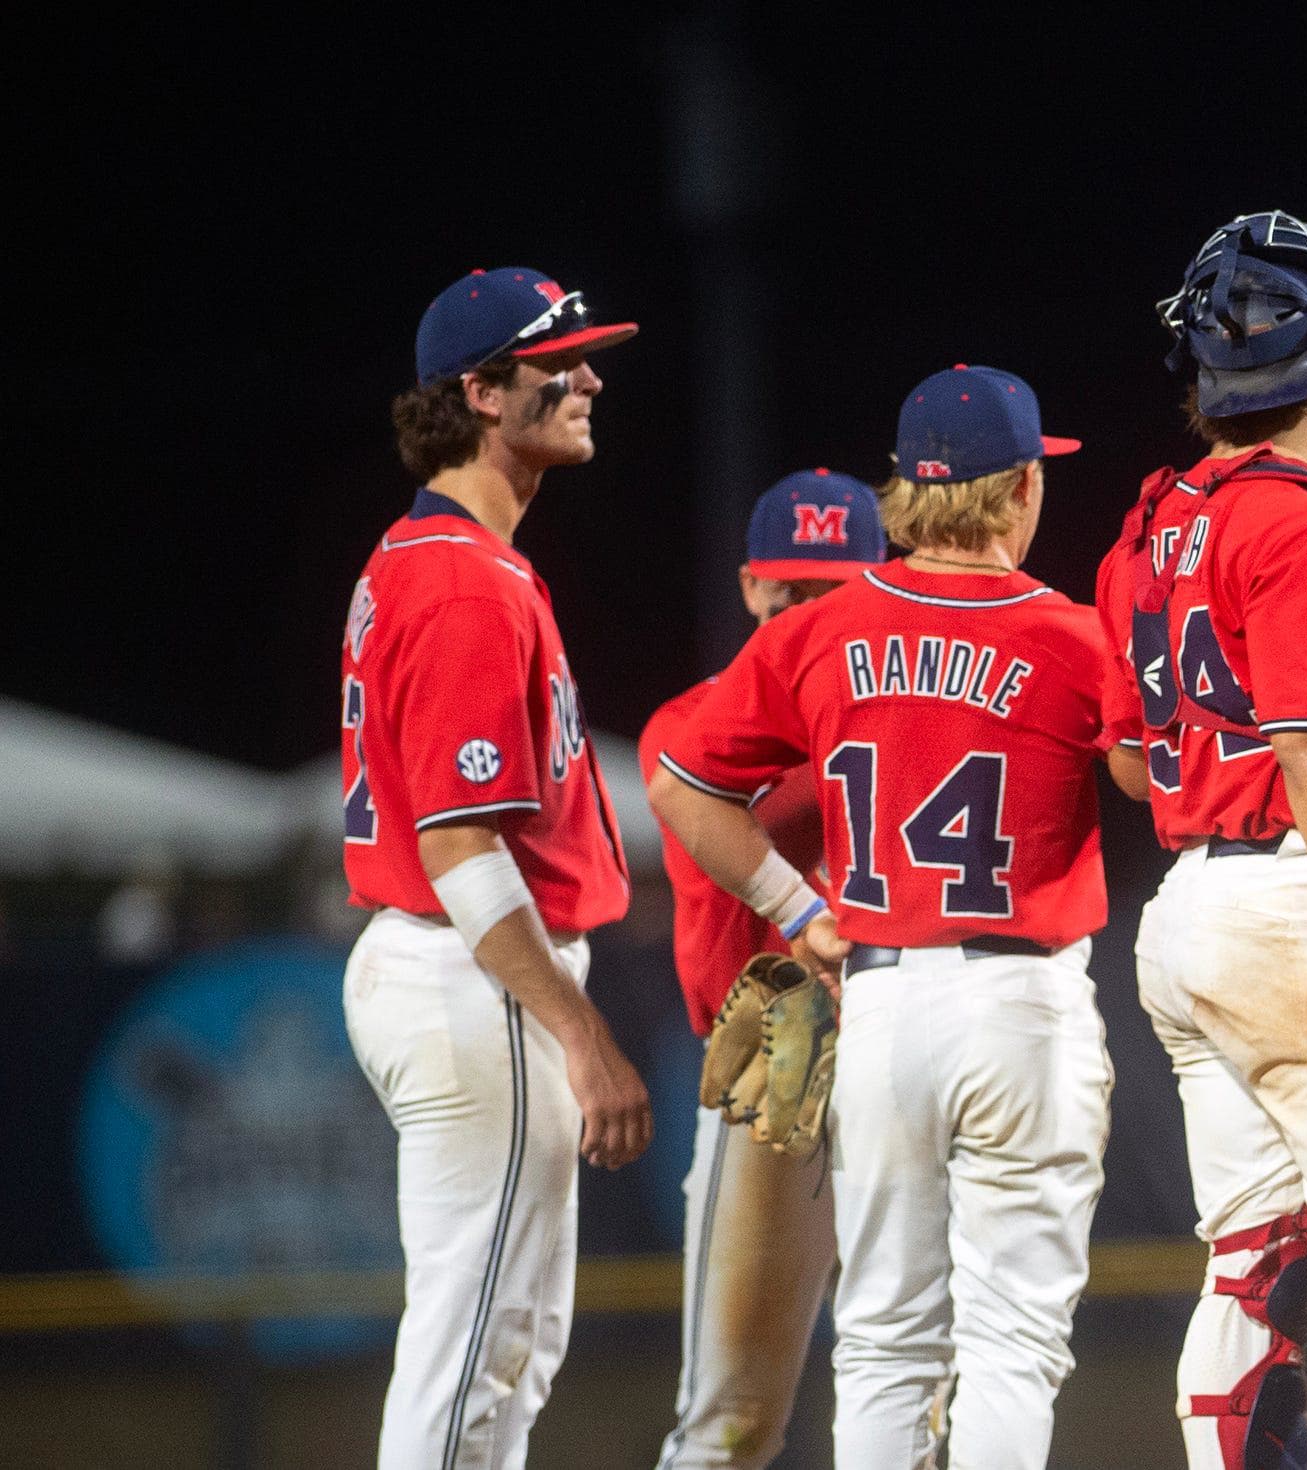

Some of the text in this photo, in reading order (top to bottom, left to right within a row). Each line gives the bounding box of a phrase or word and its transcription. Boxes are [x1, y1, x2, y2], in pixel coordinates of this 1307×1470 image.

[792, 503, 849, 546] M
[845, 634, 1033, 719] RANDLE
[456, 738, 501, 782] SEC
[824, 742, 1014, 919] 14
